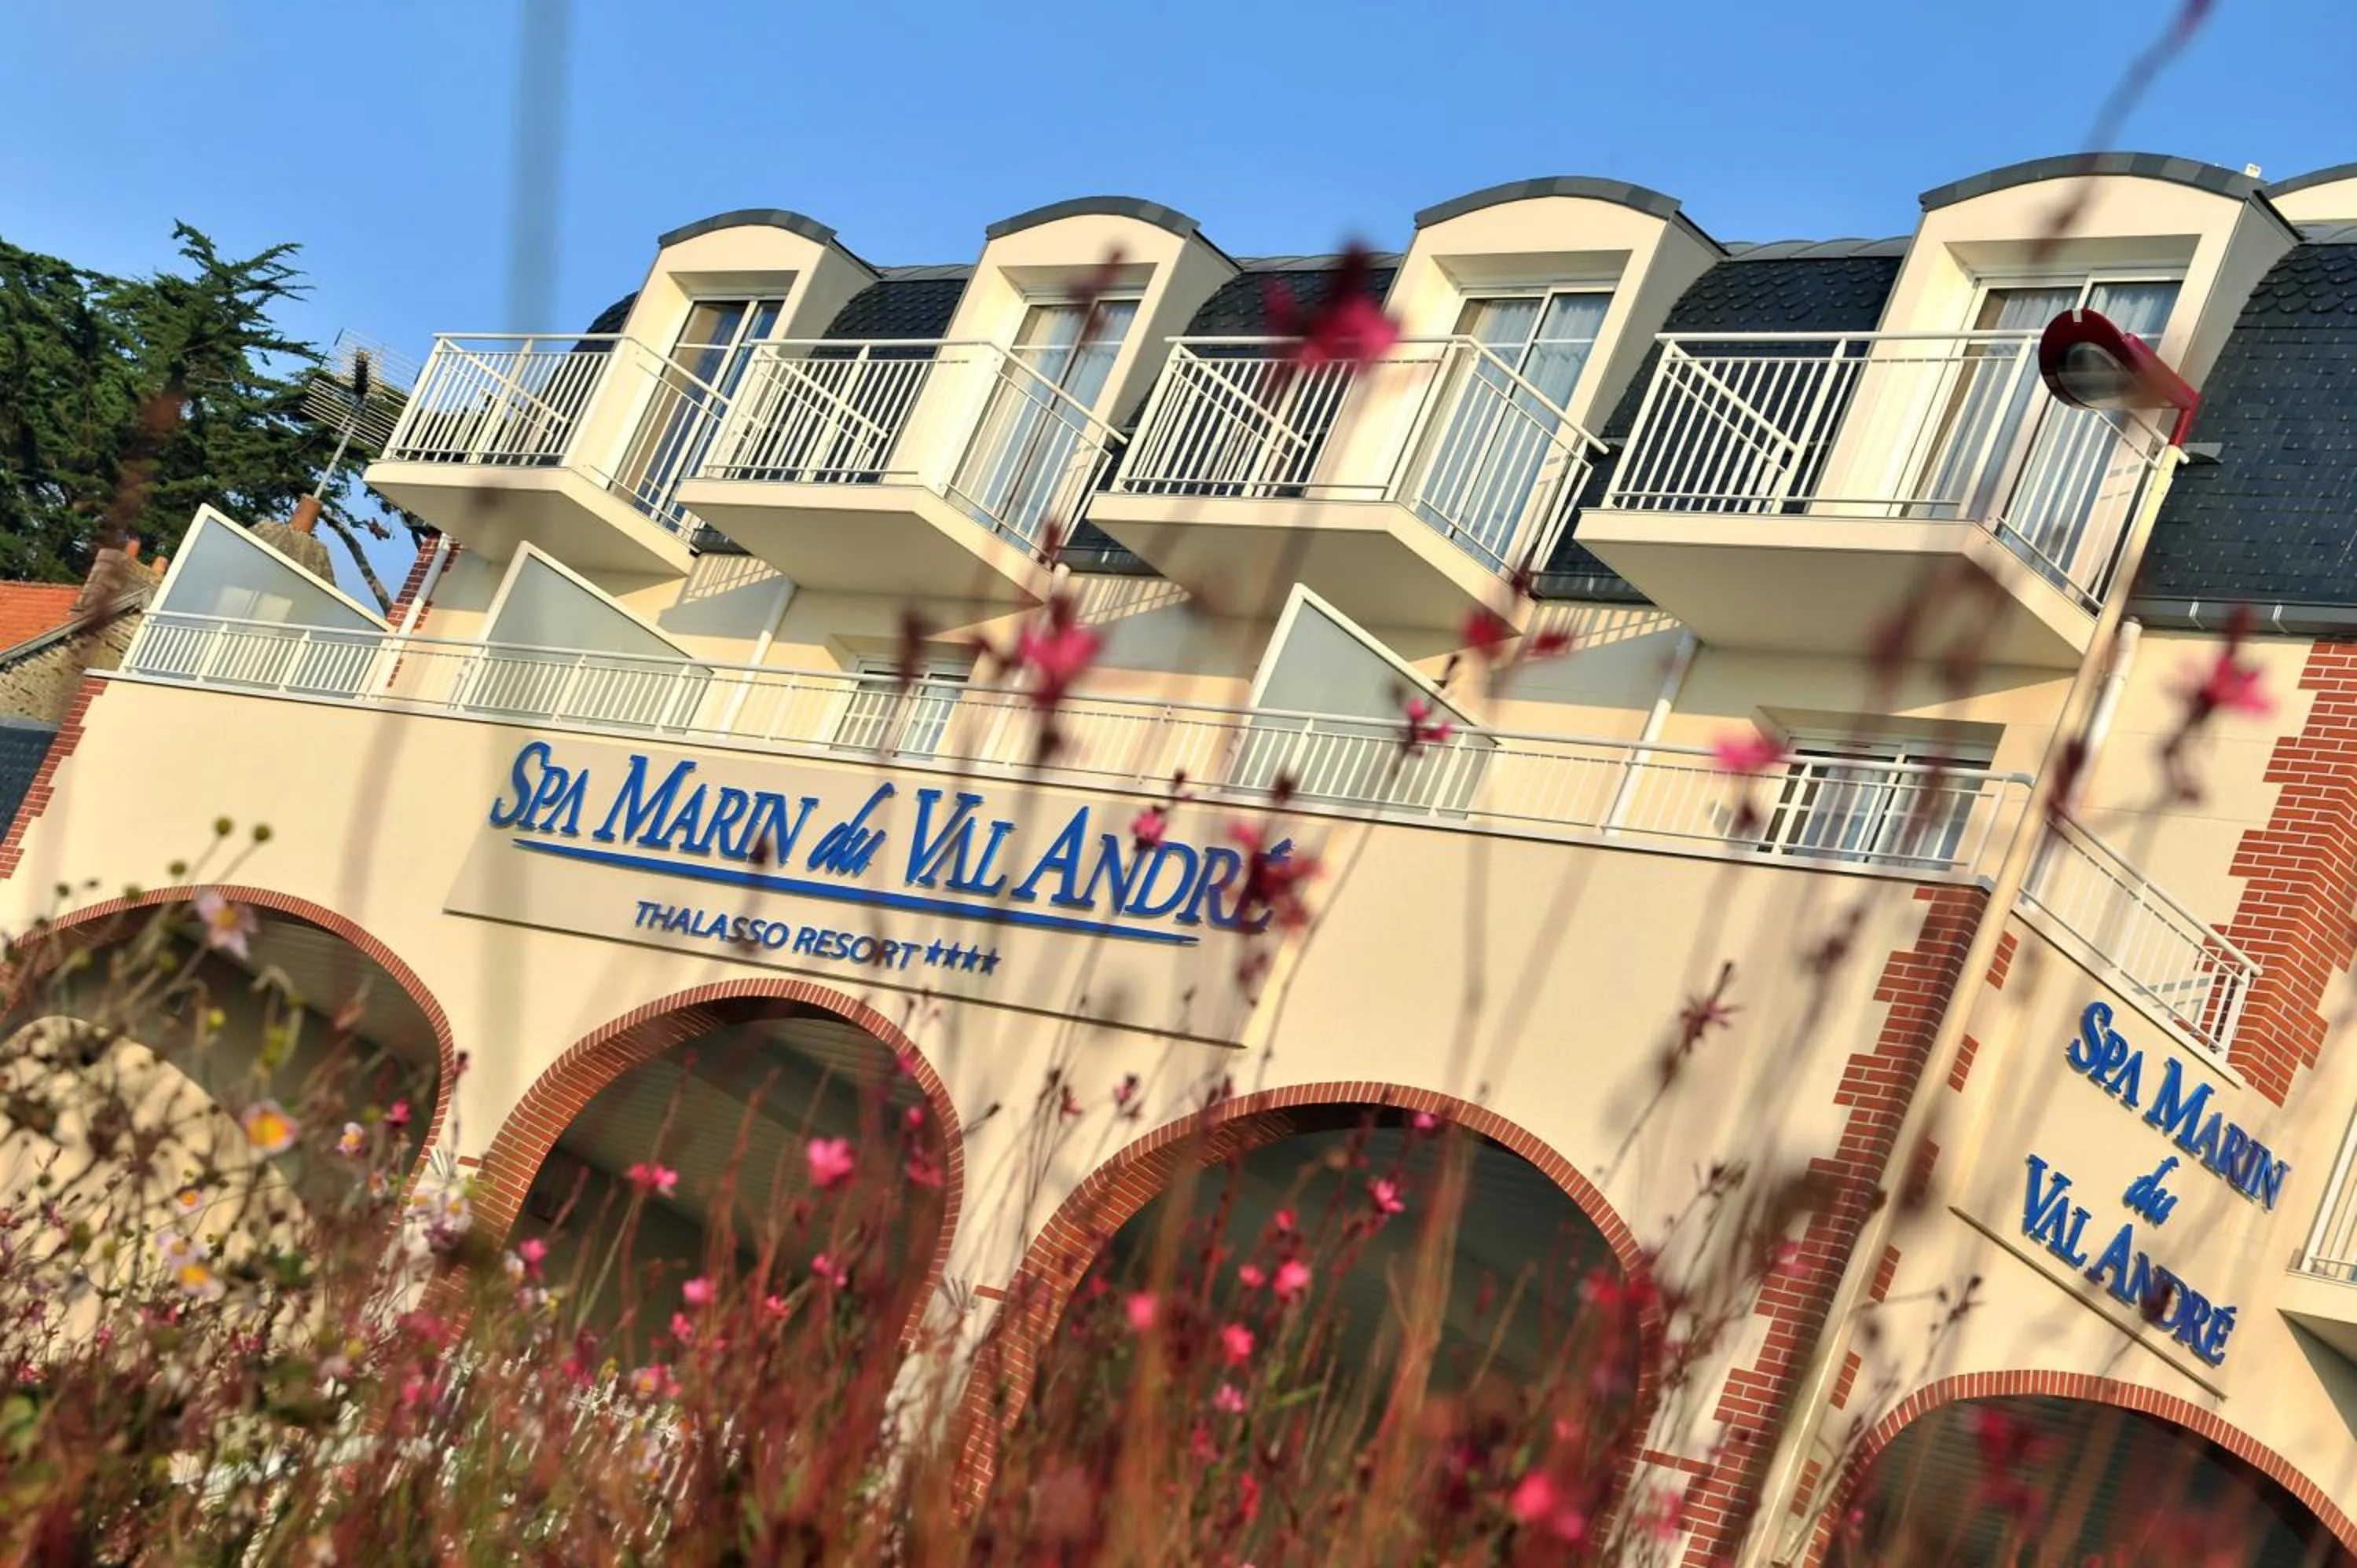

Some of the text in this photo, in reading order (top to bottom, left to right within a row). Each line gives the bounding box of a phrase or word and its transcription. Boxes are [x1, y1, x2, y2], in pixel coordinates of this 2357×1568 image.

[489, 741, 591, 837] SPA
[592, 754, 819, 865] MARIN
[807, 782, 896, 875] du
[904, 788, 1015, 896] VAL
[635, 900, 922, 971] THALASSO RESORT
[2066, 1001, 2291, 1211] SPA MARIN
[2022, 1153, 2238, 1368] VAL ANDRÉ
[2122, 1156, 2179, 1225] du
